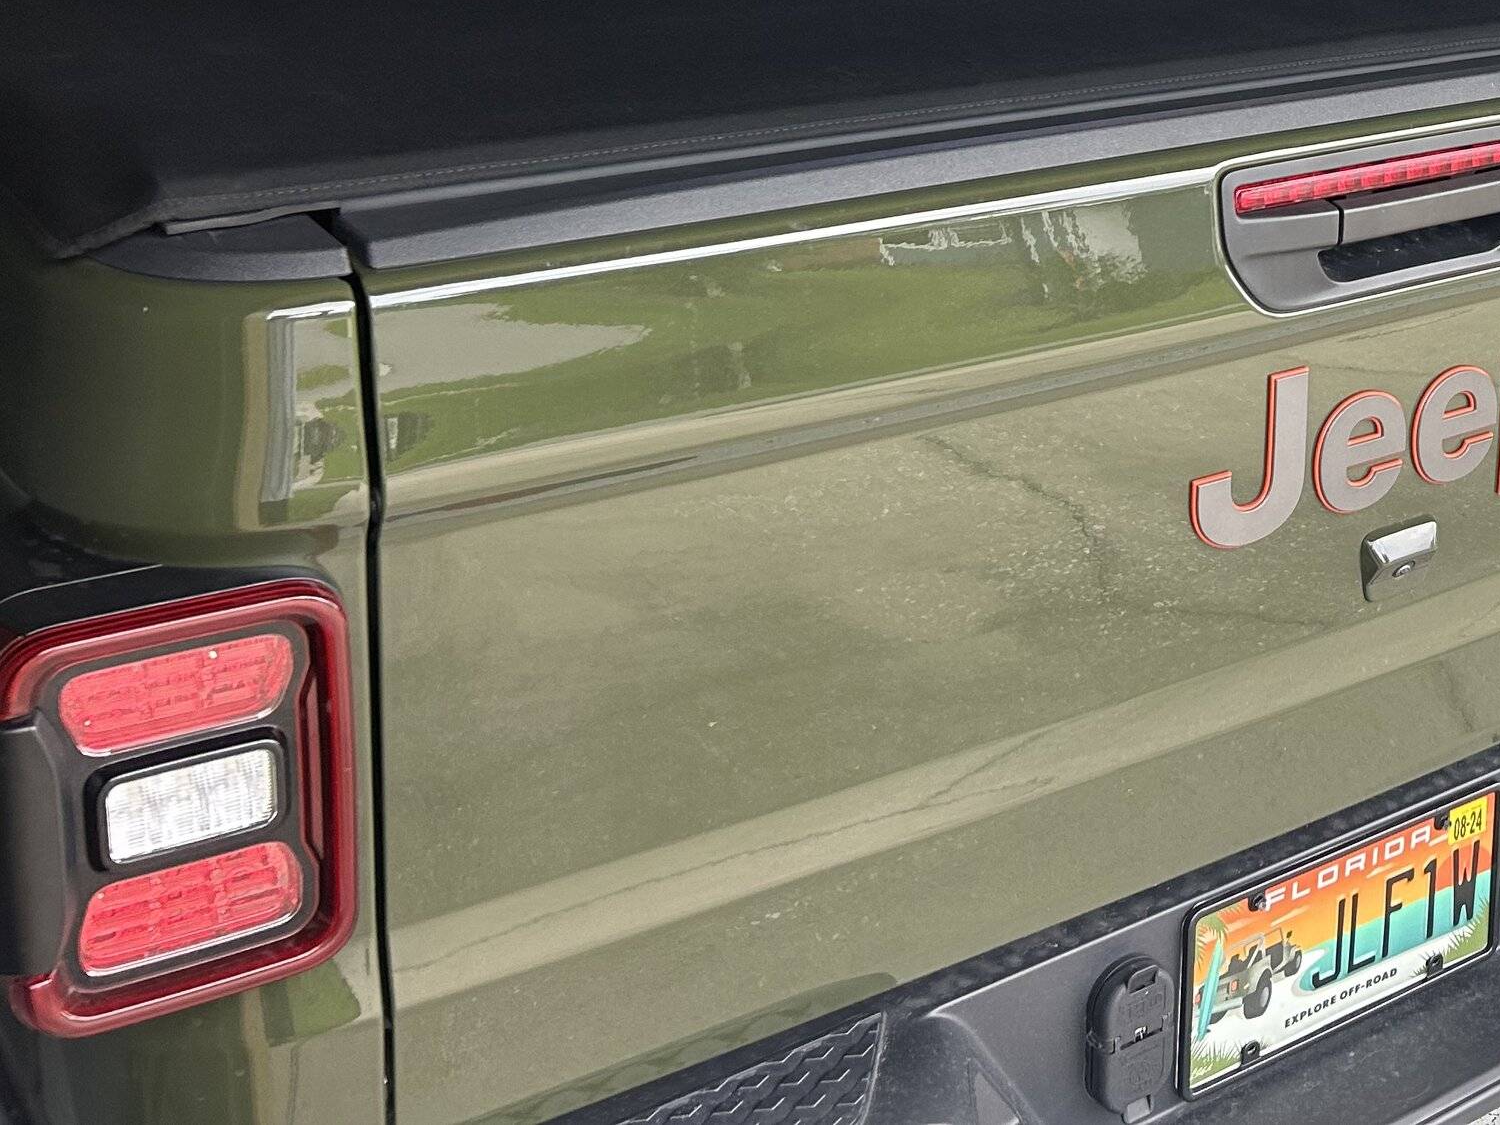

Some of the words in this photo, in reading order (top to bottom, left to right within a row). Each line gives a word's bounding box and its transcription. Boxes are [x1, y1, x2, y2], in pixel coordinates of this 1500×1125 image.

[1453, 809, 1482, 841] 08-24
[1263, 825, 1431, 910] FLORIDA
[1311, 841, 1480, 990] JLF1W
[1283, 993, 1338, 1029] EXPLORE
[1339, 967, 1398, 1002] OFF-ROAD
